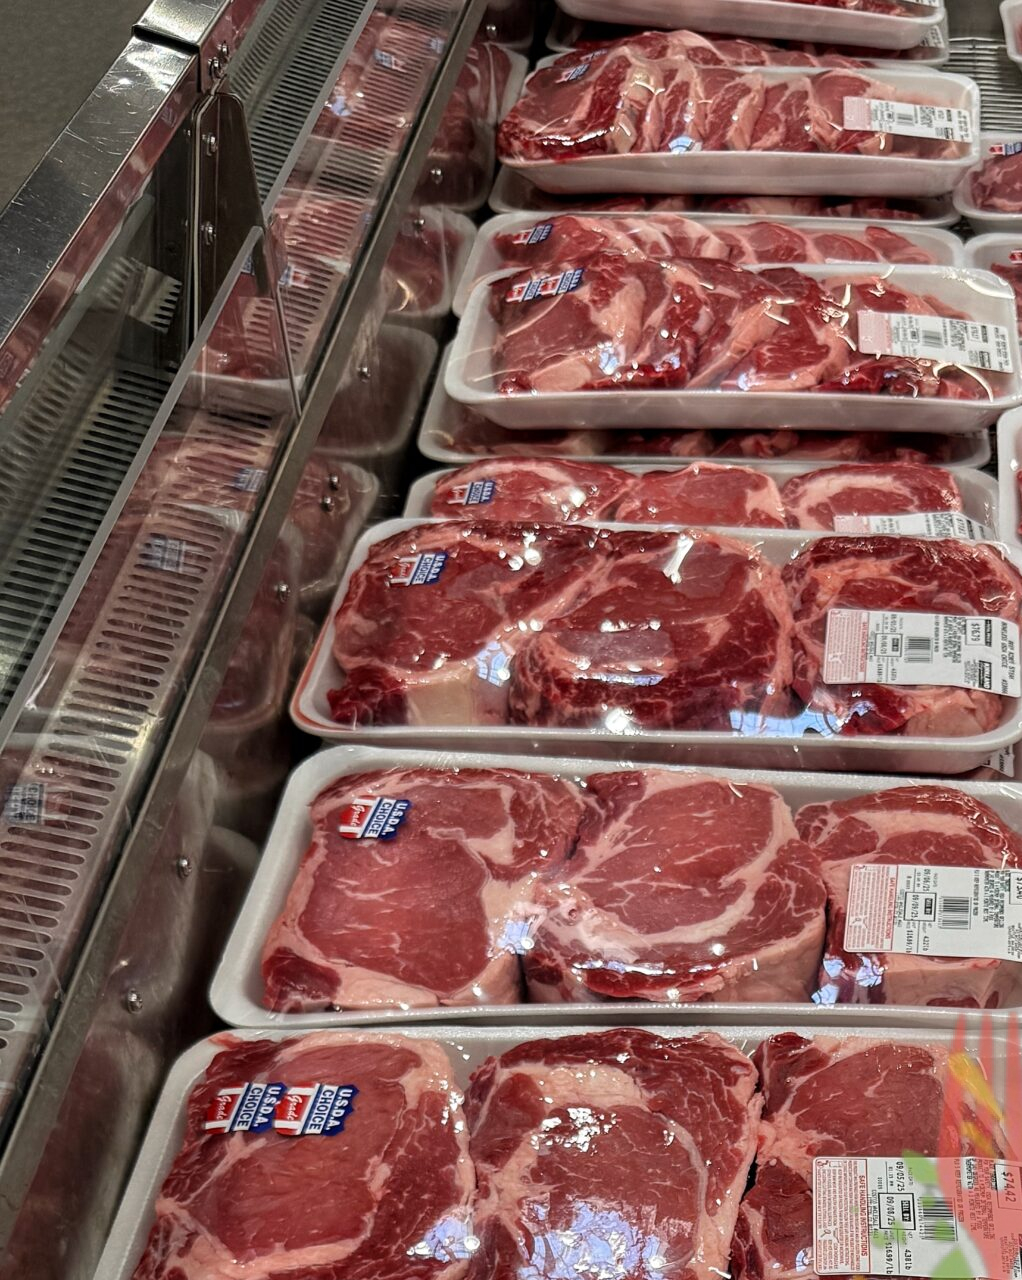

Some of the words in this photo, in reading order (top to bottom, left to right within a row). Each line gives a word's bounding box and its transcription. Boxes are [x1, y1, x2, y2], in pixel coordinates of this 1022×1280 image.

[416, 557, 432, 582] CHOICE
[368, 802, 393, 835] CHOICE
[381, 802, 408, 835] U.S.D.A.
[216, 1095, 232, 1120] Grade
[237, 1087, 263, 1128] CHOICE
[253, 1087, 280, 1128] U.S.D.A.
[287, 1094, 303, 1121] Grade
[308, 1089, 335, 1131] CHOICE
[325, 1089, 353, 1131] U.S.D.A.
[858, 1174, 866, 1189] SAFE
[1002, 1171, 1017, 1202] $74.42
[859, 1189, 867, 1216] HANDLING
[860, 1216, 868, 1256] INSTRUCTIONS
